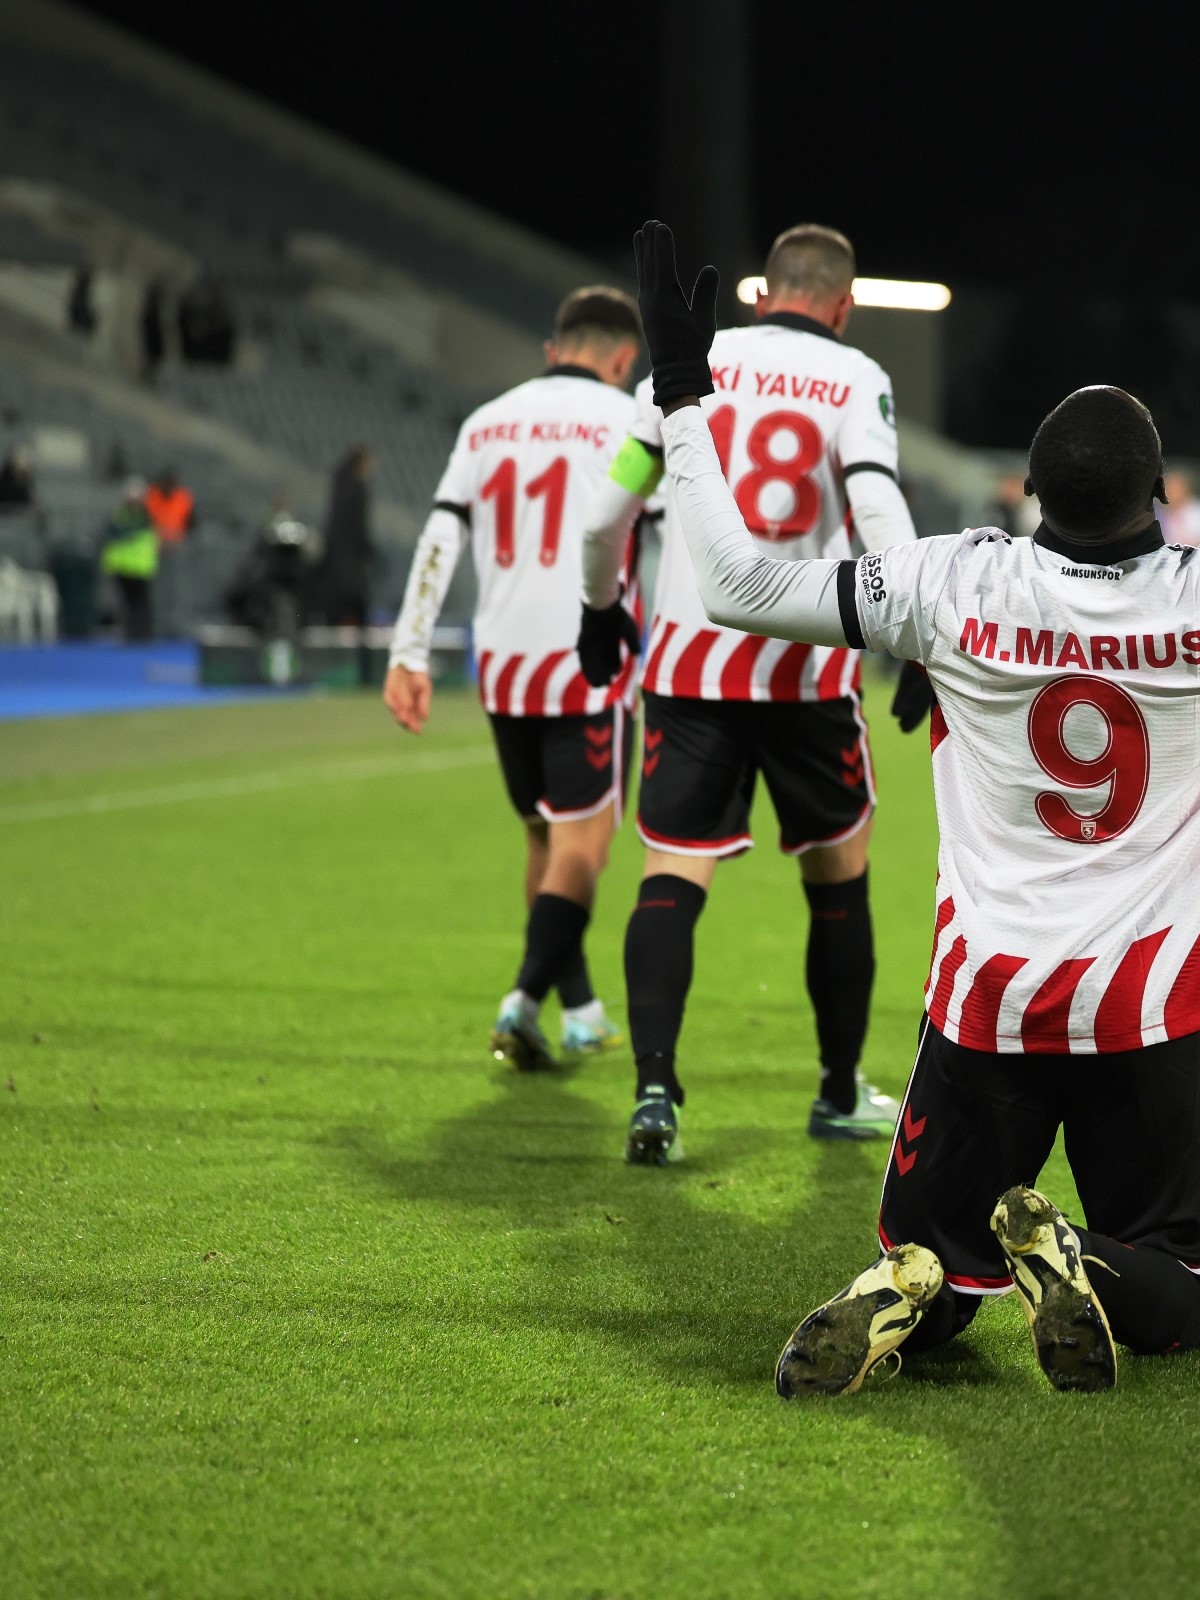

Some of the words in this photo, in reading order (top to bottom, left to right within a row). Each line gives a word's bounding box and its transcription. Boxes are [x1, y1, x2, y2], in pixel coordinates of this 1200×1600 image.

[754, 371, 851, 407] YAVRU
[480, 455, 568, 570] 11
[862, 579, 873, 604] GROUP
[1060, 566, 1121, 581] SAMSUNSPOR
[1027, 673, 1151, 845] 9
